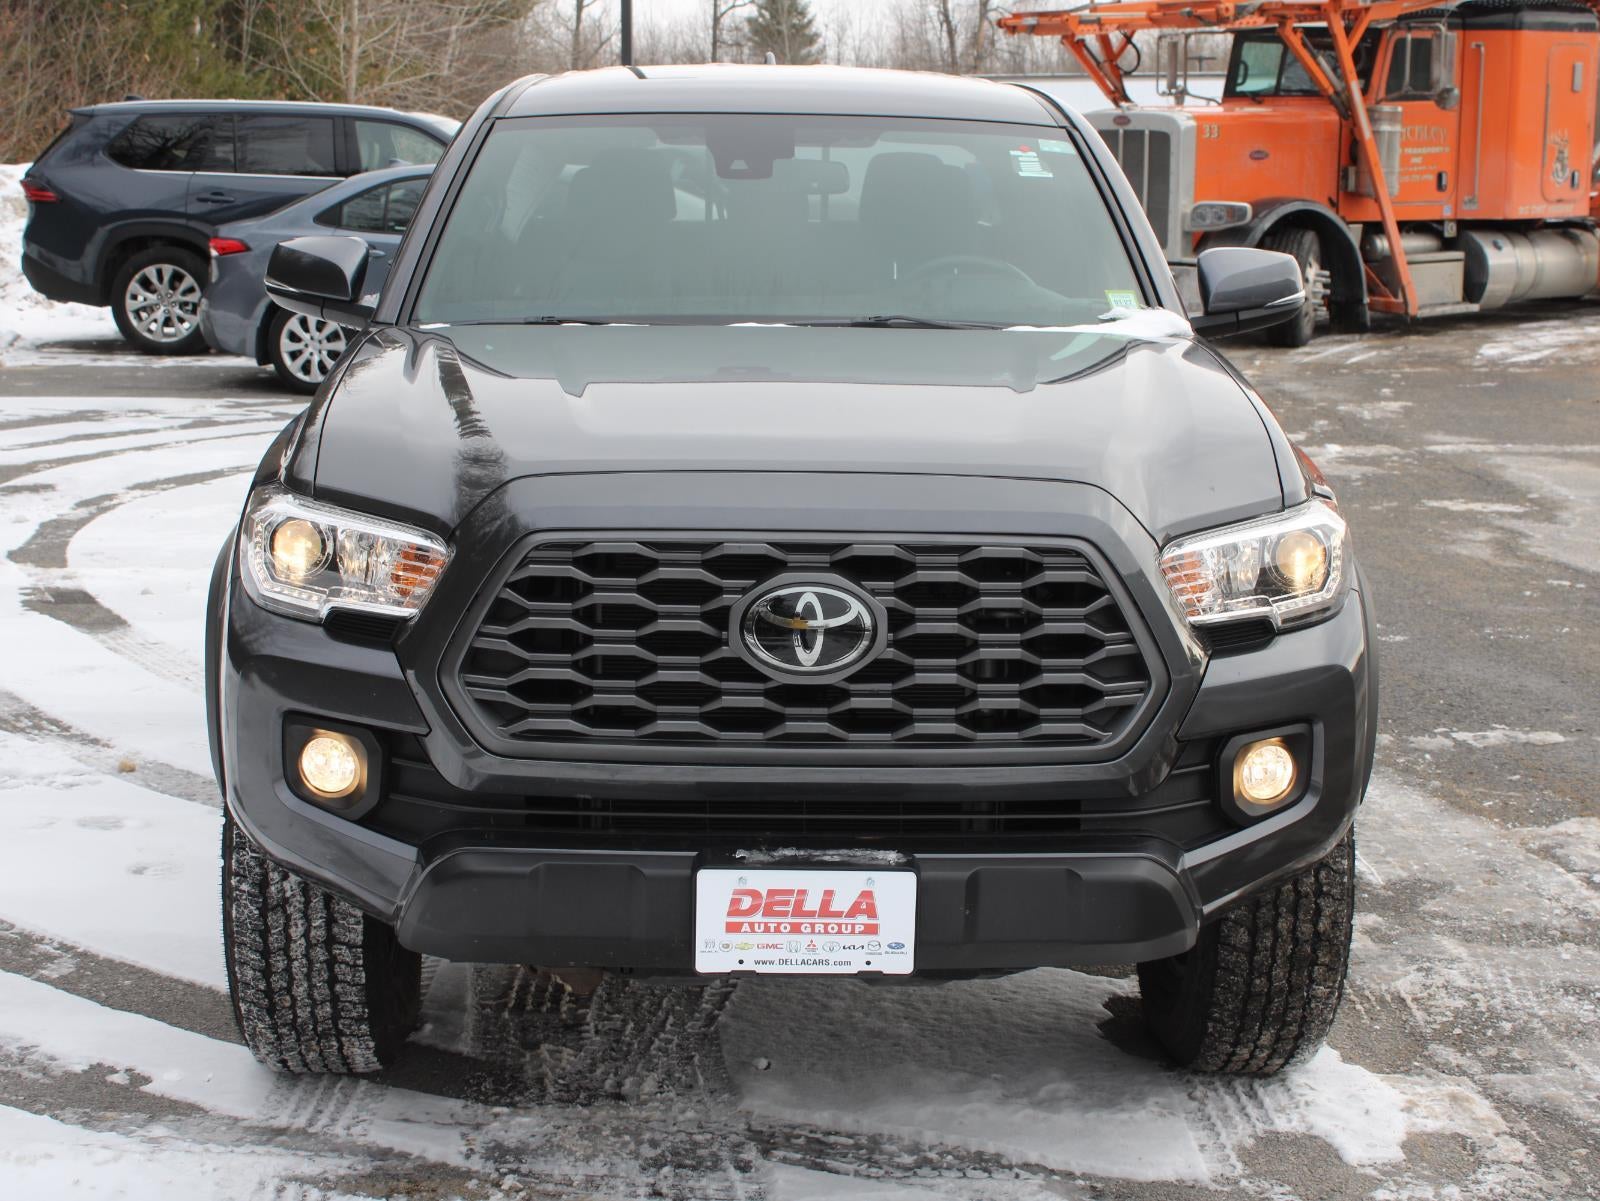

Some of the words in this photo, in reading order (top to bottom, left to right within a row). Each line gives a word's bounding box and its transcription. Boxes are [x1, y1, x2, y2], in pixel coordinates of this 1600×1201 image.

[727, 888, 879, 919] DELLA
[741, 922, 790, 934] AUTO
[801, 922, 865, 934] GROUP
[754, 958, 852, 967] www.DELLACARS.com
